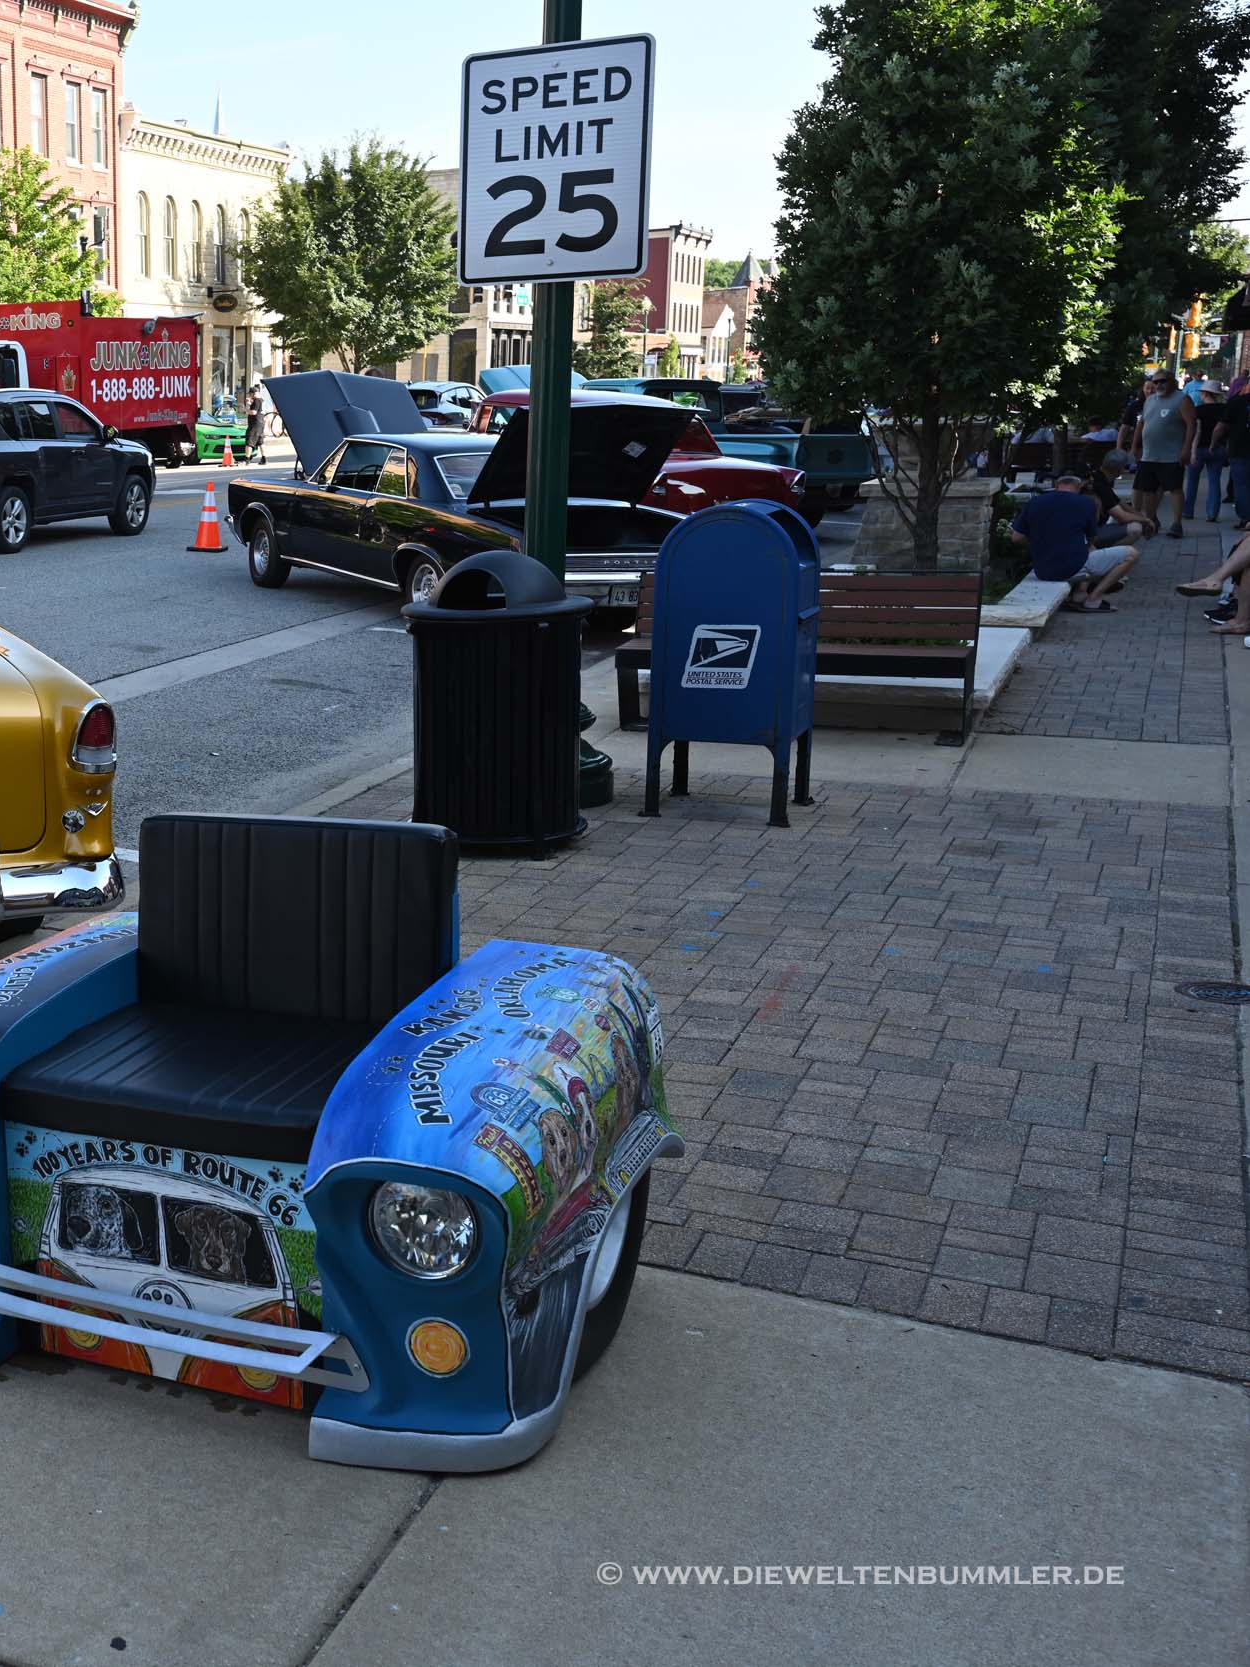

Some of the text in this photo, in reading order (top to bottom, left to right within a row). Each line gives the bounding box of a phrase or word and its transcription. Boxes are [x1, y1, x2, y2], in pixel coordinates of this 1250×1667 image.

[481, 65, 632, 115] SPEED
[495, 117, 614, 163] LIMIT
[484, 168, 619, 257] 25
[10, 307, 62, 331] KING
[90, 334, 191, 371] JUNK KING
[90, 375, 191, 403] 1-888-888-JUNK
[714, 678, 744, 686] SERVICE
[492, 957, 578, 1019] OKLAHOMA
[400, 988, 485, 1037] KANSAS
[408, 1030, 485, 1126] MISSOURI
[488, 1089, 510, 1106] 66
[32, 1138, 302, 1227] 100 YEARS OF ROUTE 66
